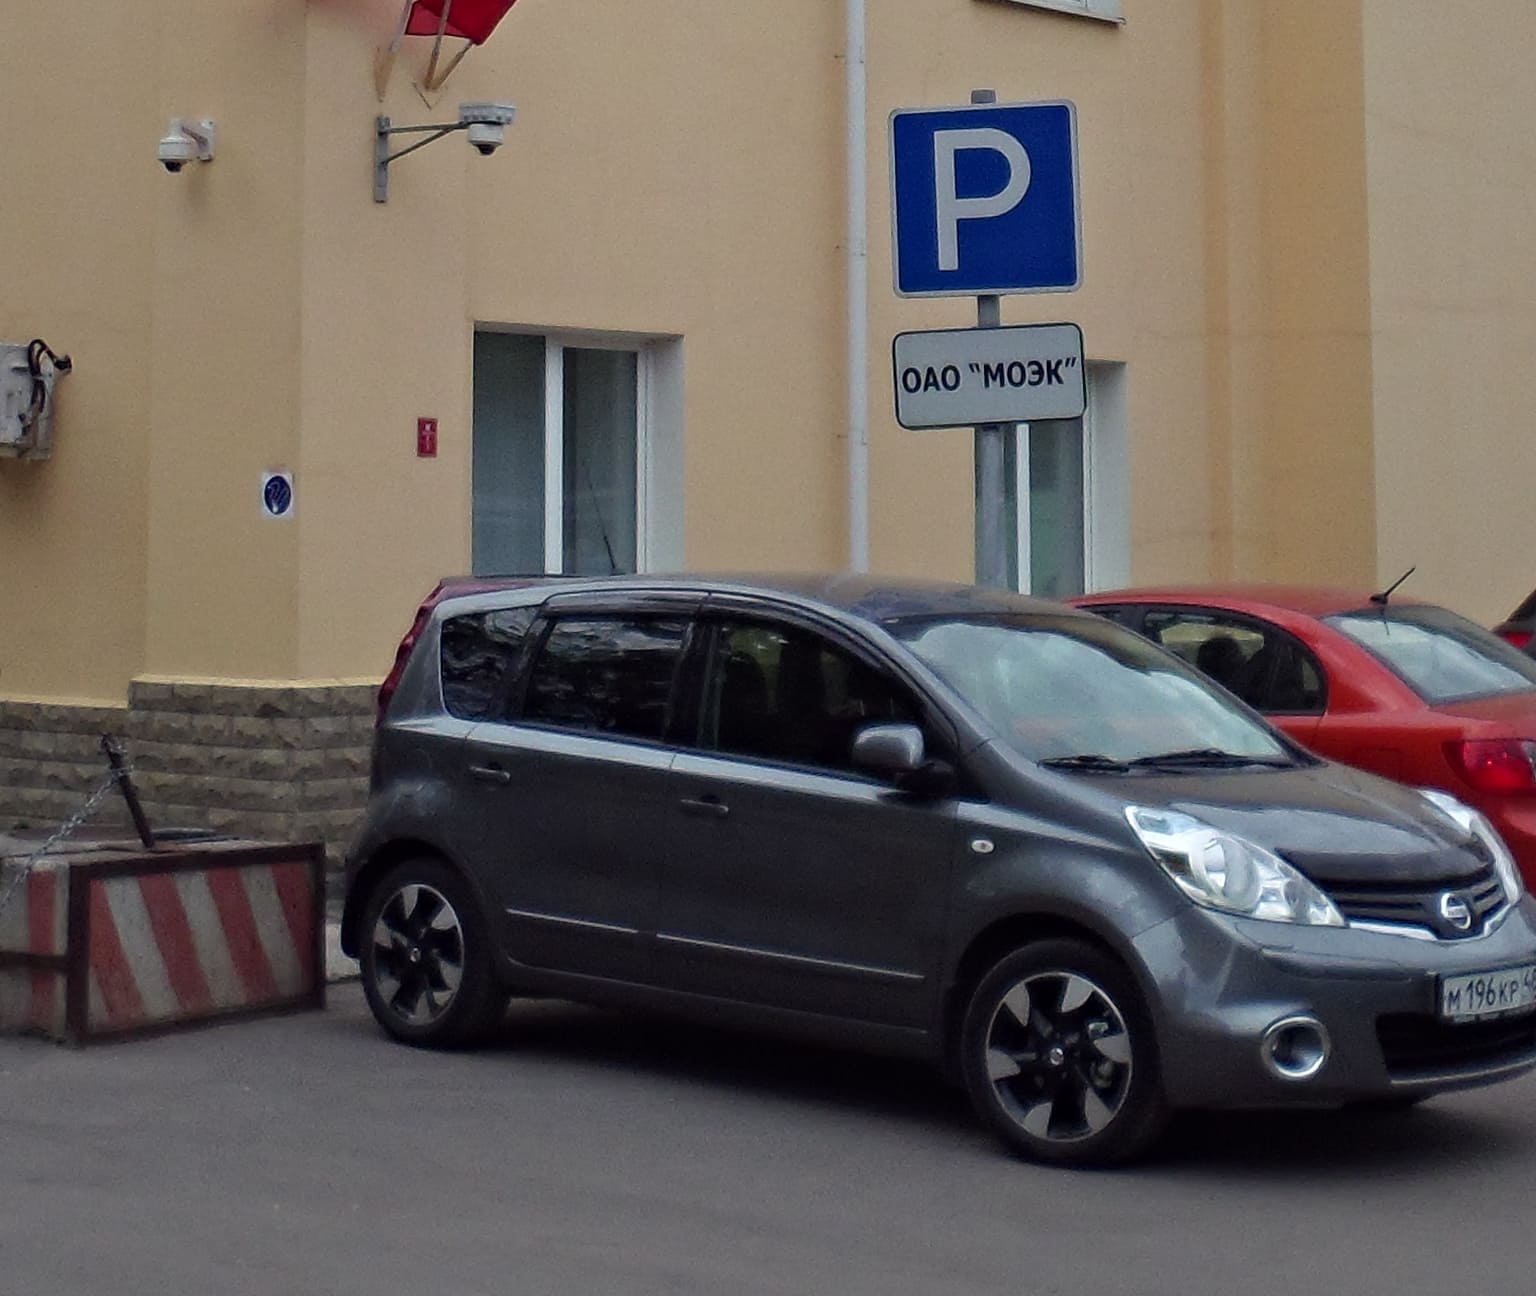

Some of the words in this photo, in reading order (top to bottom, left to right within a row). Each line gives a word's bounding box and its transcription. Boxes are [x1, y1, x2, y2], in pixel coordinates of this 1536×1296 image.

[933, 127, 1032, 272] P
[901, 364, 962, 394] ОАО
[968, 356, 1077, 389] "МОЭК"
